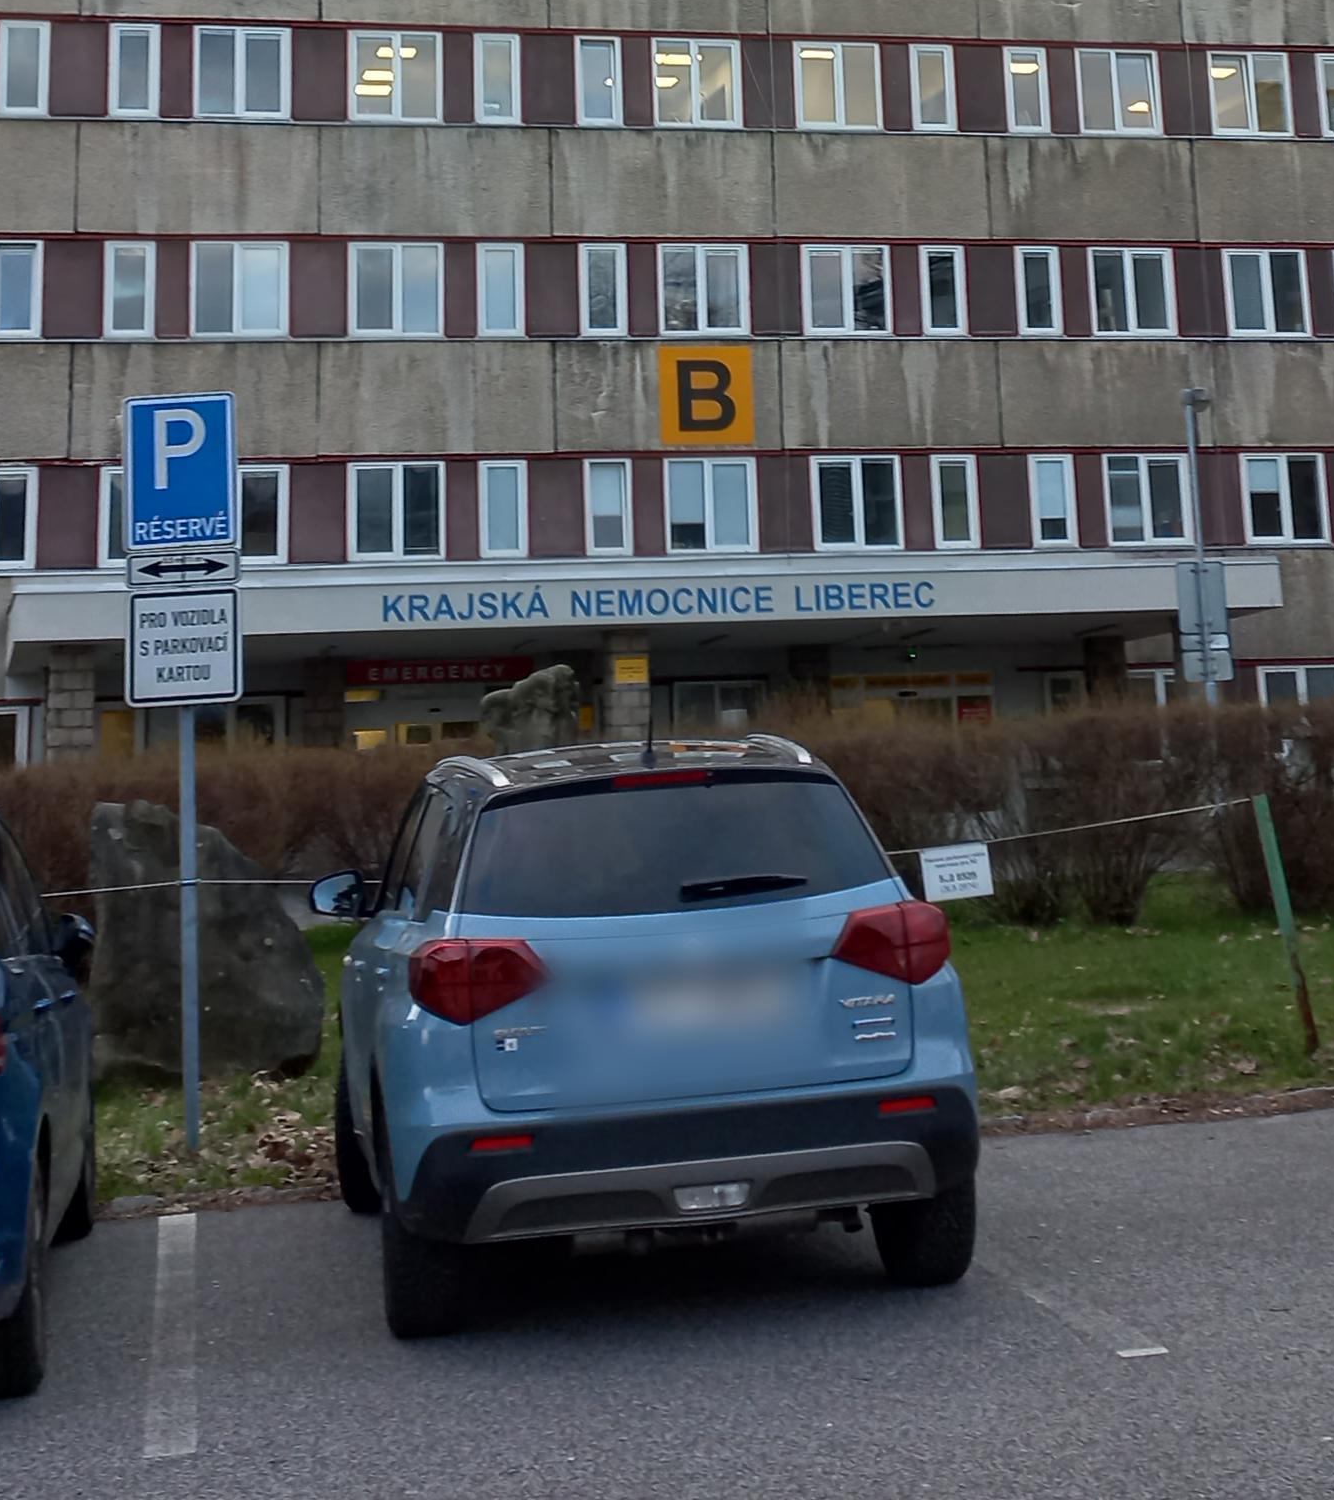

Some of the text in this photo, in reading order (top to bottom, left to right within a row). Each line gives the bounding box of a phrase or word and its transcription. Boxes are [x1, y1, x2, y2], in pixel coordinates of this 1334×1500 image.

[676, 360, 736, 432] B
[153, 408, 207, 490] P
[134, 510, 228, 542] RÉSERVÉ
[382, 581, 937, 622] KRAJSKÁ NEMOCNICE LIBEREC
[139, 609, 228, 629] PRO VOZIDLA
[139, 631, 229, 657] S PARKOVACÍ
[156, 665, 211, 683] KARTOU
[367, 664, 506, 681] EMERGENCY
